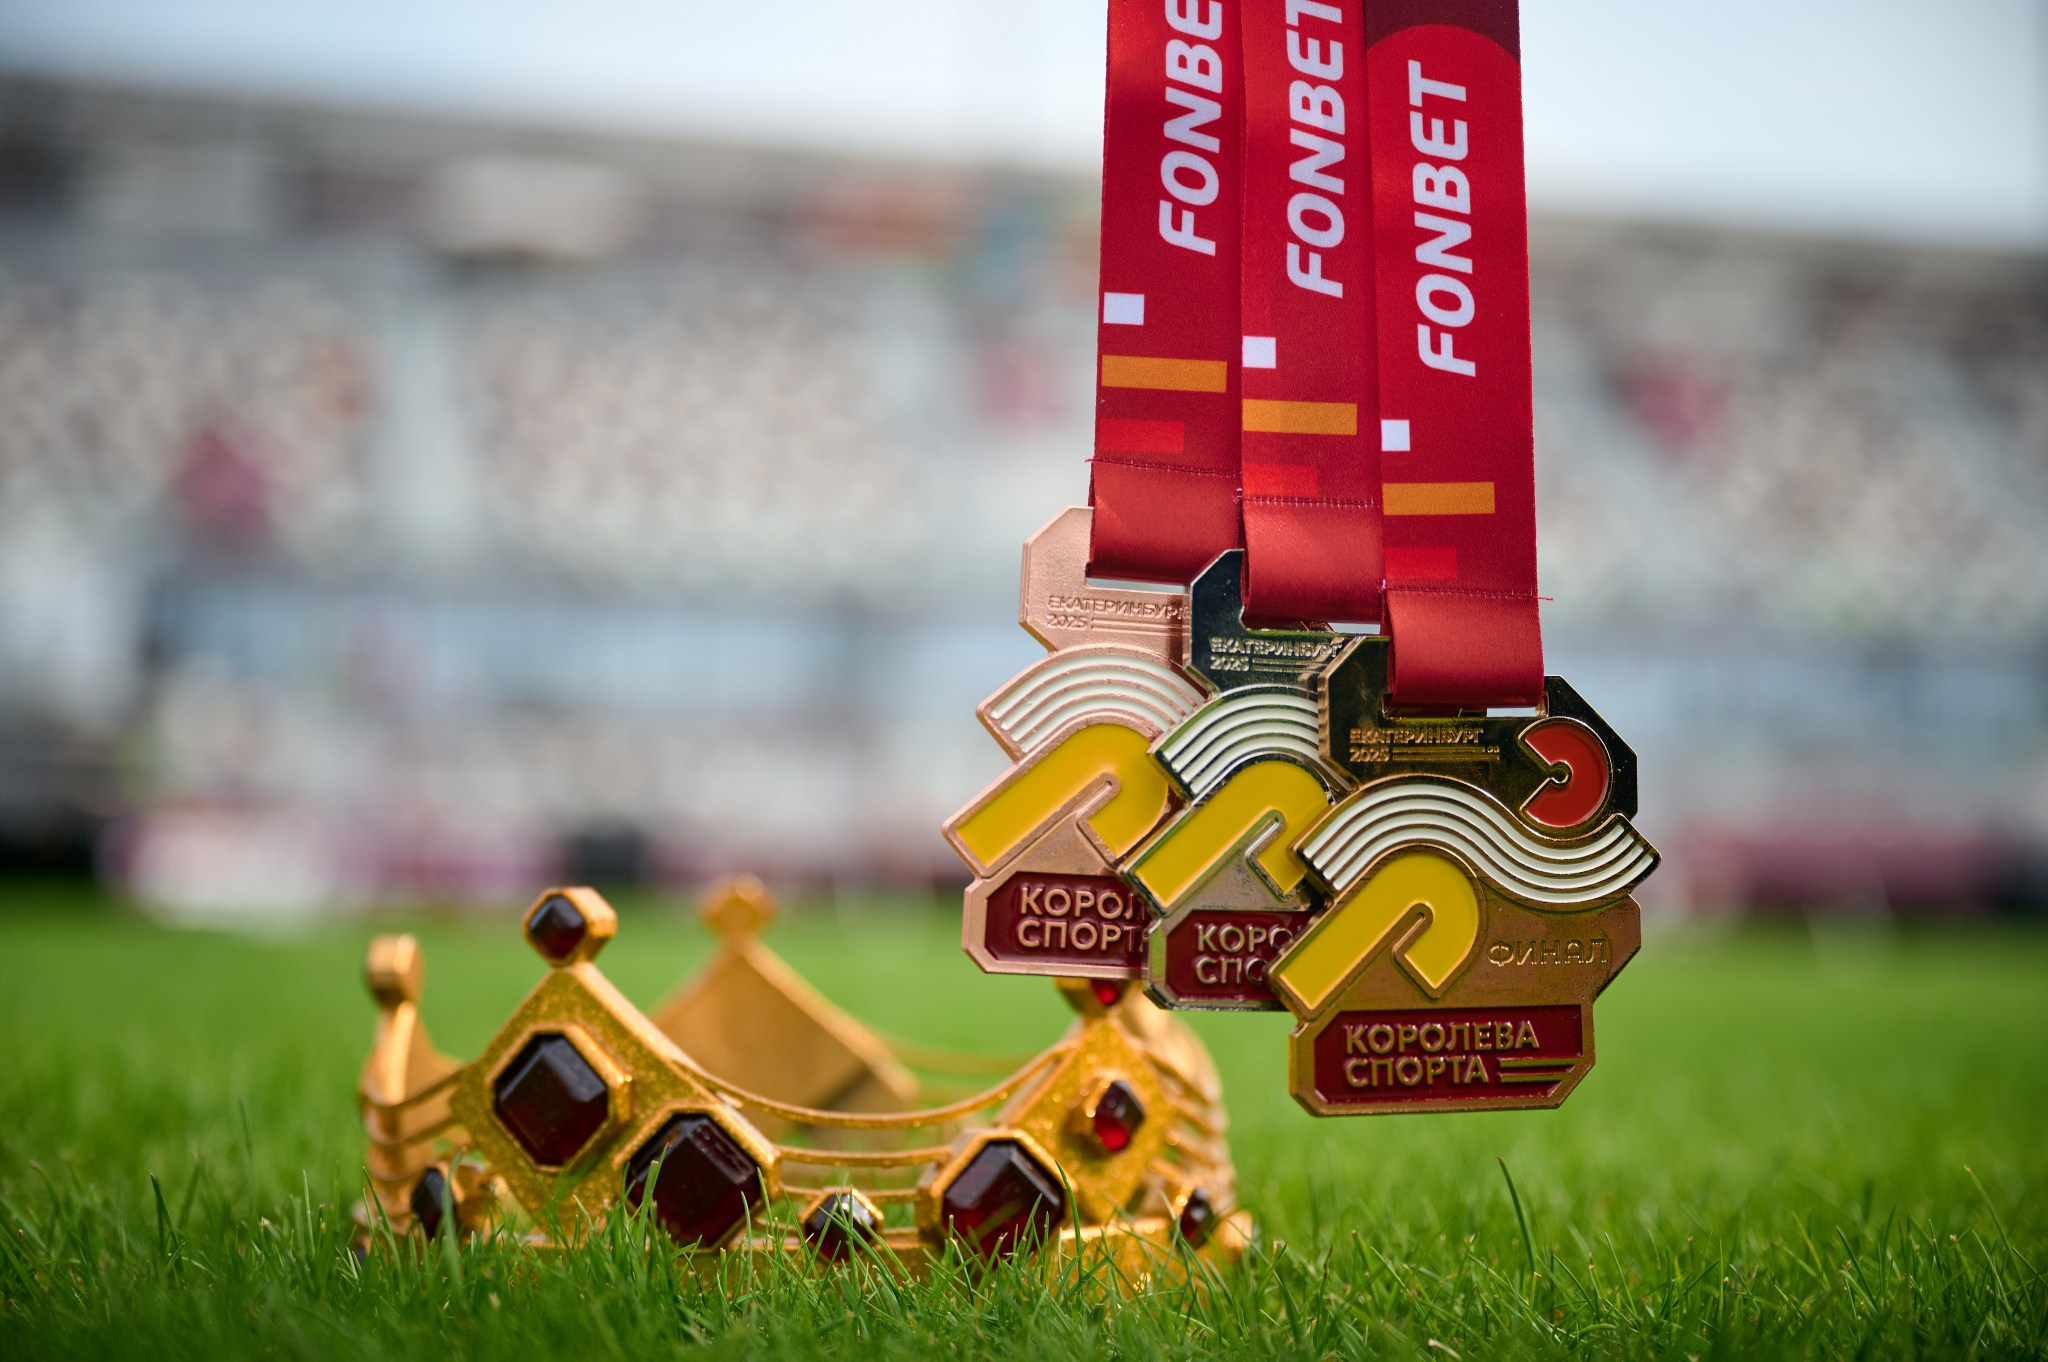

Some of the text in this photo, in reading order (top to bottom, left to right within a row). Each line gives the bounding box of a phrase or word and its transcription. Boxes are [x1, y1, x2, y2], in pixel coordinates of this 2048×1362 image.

[1159, 0, 1223, 257] FONBE
[1408, 60, 1477, 378] FONBET
[1047, 614, 1088, 631] 2025
[1209, 636, 1342, 658] ЕКАТЕРИНБУРГ
[1209, 655, 1250, 672] 2025
[1350, 728, 1484, 744] ЕКАТЕРИНБУРГ
[1350, 746, 1390, 762] 2025
[1020, 887, 1146, 920] КОРОЛ
[1197, 923, 1296, 953] КОРО
[1488, 938, 1609, 967] ФИНАЛ
[1195, 957, 1270, 985] СПО
[1344, 1020, 1540, 1055] КОРОЛЕВА
[1344, 1054, 1489, 1088] СПОРТА
